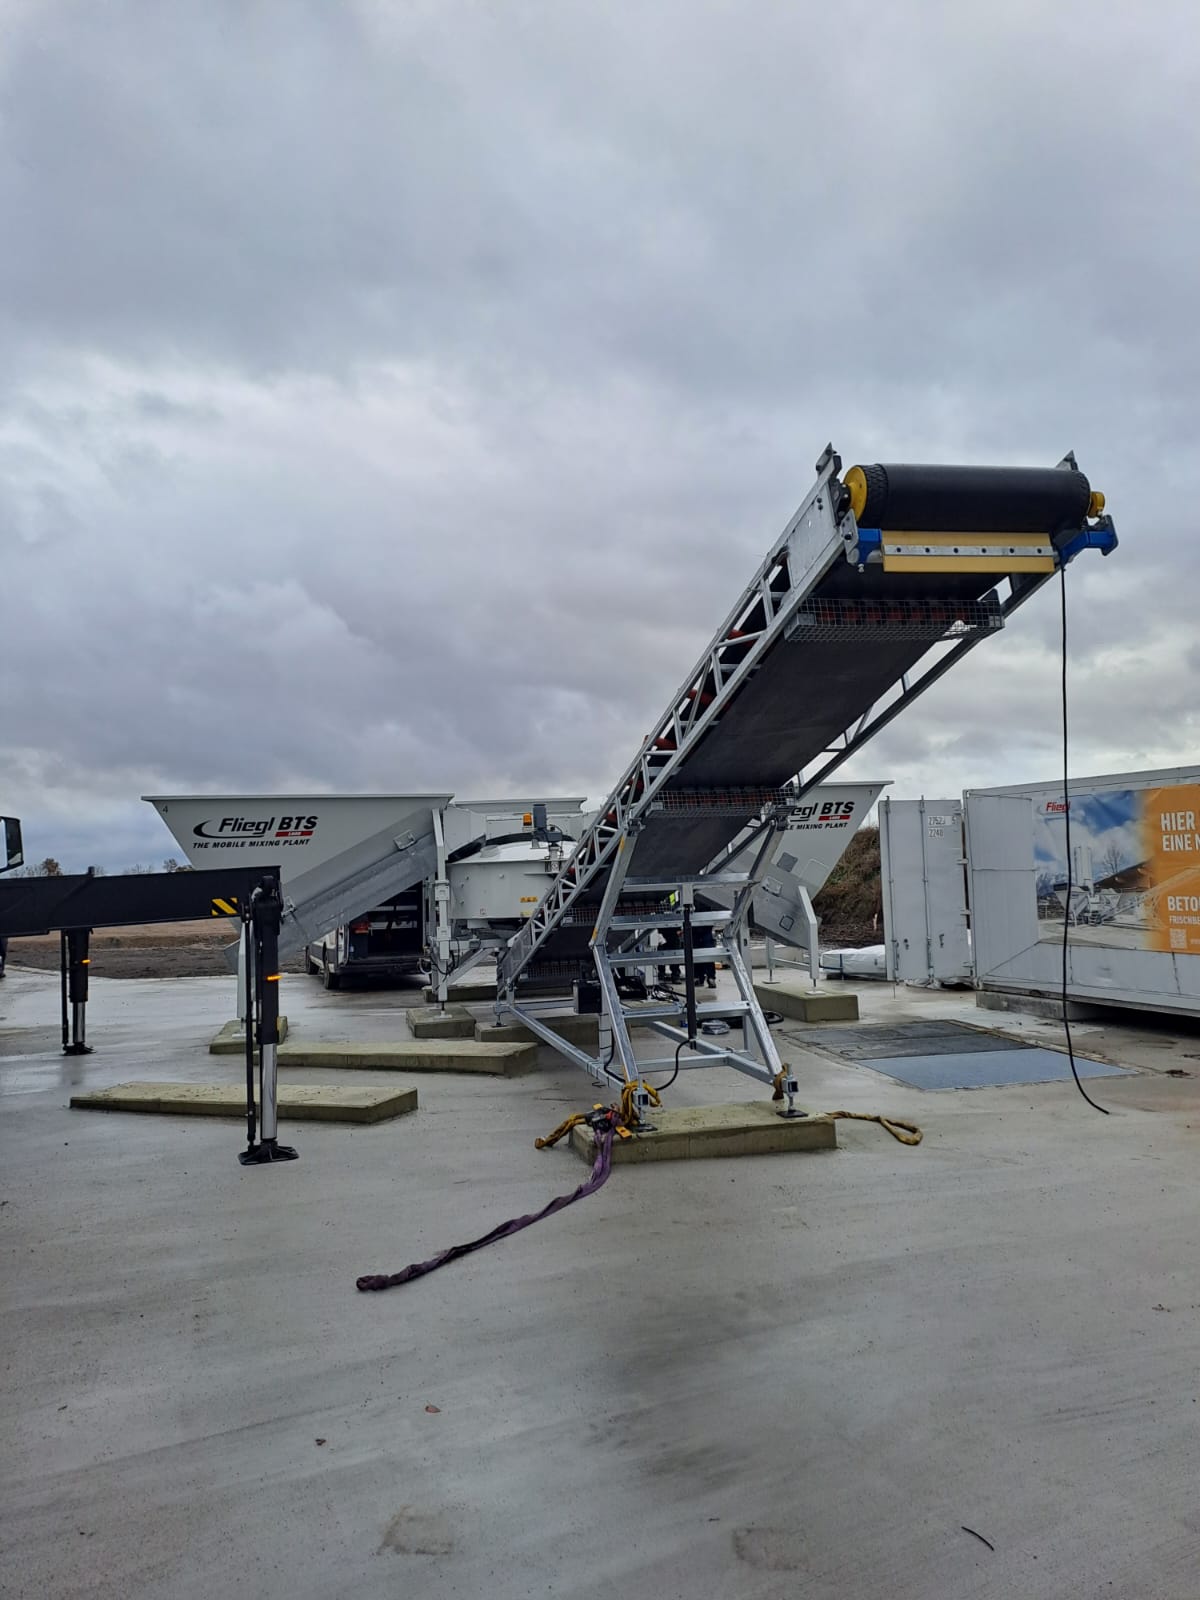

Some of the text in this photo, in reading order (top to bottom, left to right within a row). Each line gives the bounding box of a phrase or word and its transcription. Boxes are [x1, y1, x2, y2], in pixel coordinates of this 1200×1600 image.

[162, 805, 169, 814] 4
[790, 801, 855, 819] egl BTS
[218, 815, 319, 835] Fliegl BTS
[1161, 811, 1196, 831] HIER
[213, 841, 246, 849] MOBILE
[283, 838, 311, 846] PLANT
[1162, 834, 1193, 851] EINE
[1168, 896, 1200, 912] BETO
